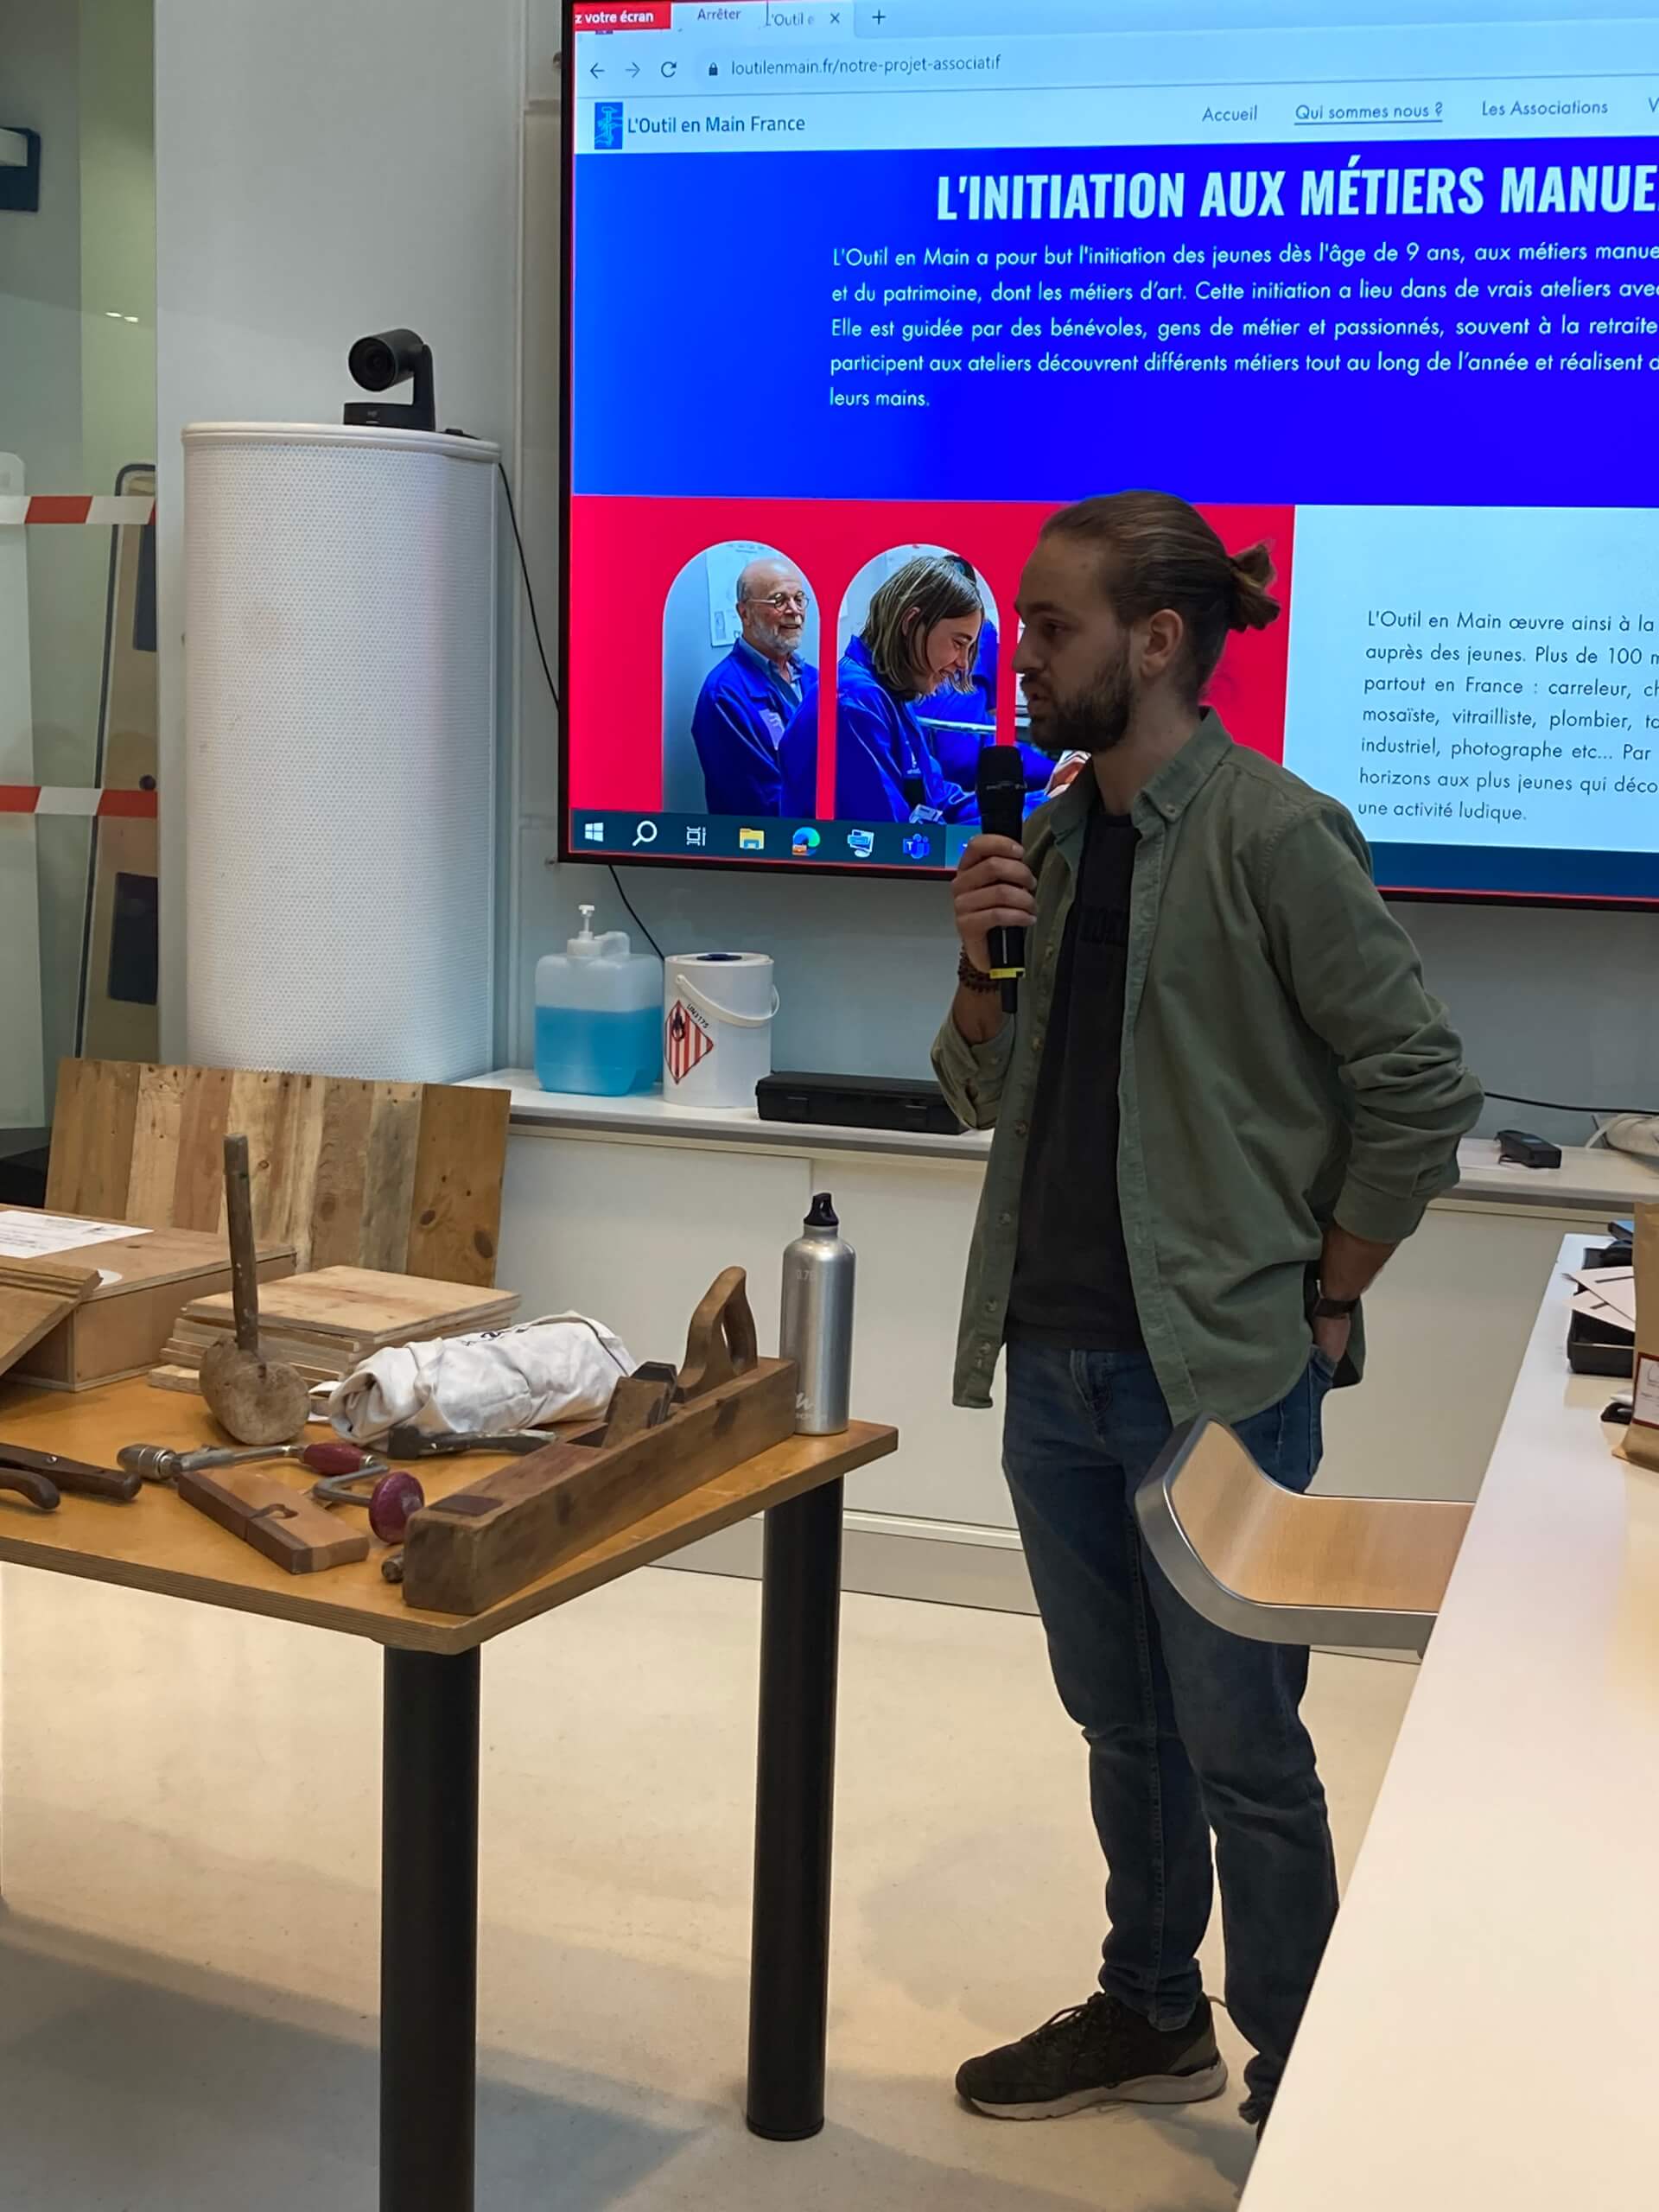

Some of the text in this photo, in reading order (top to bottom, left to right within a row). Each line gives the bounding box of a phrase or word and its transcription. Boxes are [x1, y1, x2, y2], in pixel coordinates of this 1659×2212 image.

[584, 11, 618, 24] votre
[620, 10, 654, 23] écran
[696, 8, 742, 22] Arrêter
[731, 54, 1001, 77] loutilenmain.fr/notre-projet-associatif
[1201, 104, 1258, 123] Accueil
[1295, 104, 1324, 120] Qui
[1328, 107, 1389, 119] sommes
[1393, 106, 1430, 118] nous
[1482, 99, 1609, 117] Les Associations
[627, 115, 805, 134] L'Outil en Main France
[937, 154, 1659, 221] L'INITIATION AUX MÉTIERS MANUE
[833, 246, 888, 267] L'Outil
[894, 253, 916, 267] en
[923, 246, 969, 266] Main
[976, 252, 988, 266] a
[995, 251, 1038, 270] pour
[1044, 245, 1073, 265] but
[1078, 244, 1166, 264] l'initiation
[1173, 243, 1205, 264] des
[1212, 245, 1272, 269] jeunes
[1278, 241, 1313, 264] dès
[1319, 241, 1366, 268] l'âge
[1373, 241, 1399, 263] de
[1406, 241, 1420, 262] 9
[1426, 247, 1465, 264] ans,
[1474, 247, 1511, 261] aux
[1518, 241, 1588, 261] métiers
[831, 276, 1659, 307] et du patrimoine, dont les métiers d'art. Cette initiation a lieu dans de vrais ateliers ave
[831, 314, 1658, 342] Elle est guidée par des bénévoles, gens de métier et passionnés, souvent à la retraite
[830, 354, 925, 377] participent
[929, 359, 963, 372] aux
[967, 352, 1033, 372] ateliers
[1037, 351, 1139, 372] découvrent
[1143, 351, 1228, 372] différents
[1234, 353, 1300, 372] métiers
[1306, 354, 1342, 372] tout
[1346, 358, 1371, 372] au
[1377, 350, 1421, 377] long
[1426, 350, 1452, 372] de
[1458, 350, 1529, 372] l'année
[1535, 354, 1554, 372] et
[1560, 350, 1643, 372] réalisent
[830, 386, 930, 407] leurs mains.
[1368, 610, 1655, 632] L'Outil en Main œuvre ainsi à la
[1365, 643, 1423, 664] auprès
[1430, 642, 1460, 661] des
[1467, 645, 1526, 666] jeunes.
[1535, 645, 1568, 664] Plus
[1575, 645, 1598, 664] de
[1609, 647, 1643, 665] 100
[1363, 677, 1426, 695] partout
[1434, 680, 1455, 692] en
[1465, 676, 1523, 694] France
[1548, 677, 1631, 700] carreleur,
[1363, 707, 1440, 727] mosaïste,
[1452, 707, 1537, 729] vitrailliste,
[1549, 709, 1632, 732] plombier,
[1361, 735, 1652, 762] industriel, photographe etc... Par
[1359, 766, 1658, 796] horizons aux plus jeunes qui déco
[1357, 800, 1527, 824] une activité ludique.
